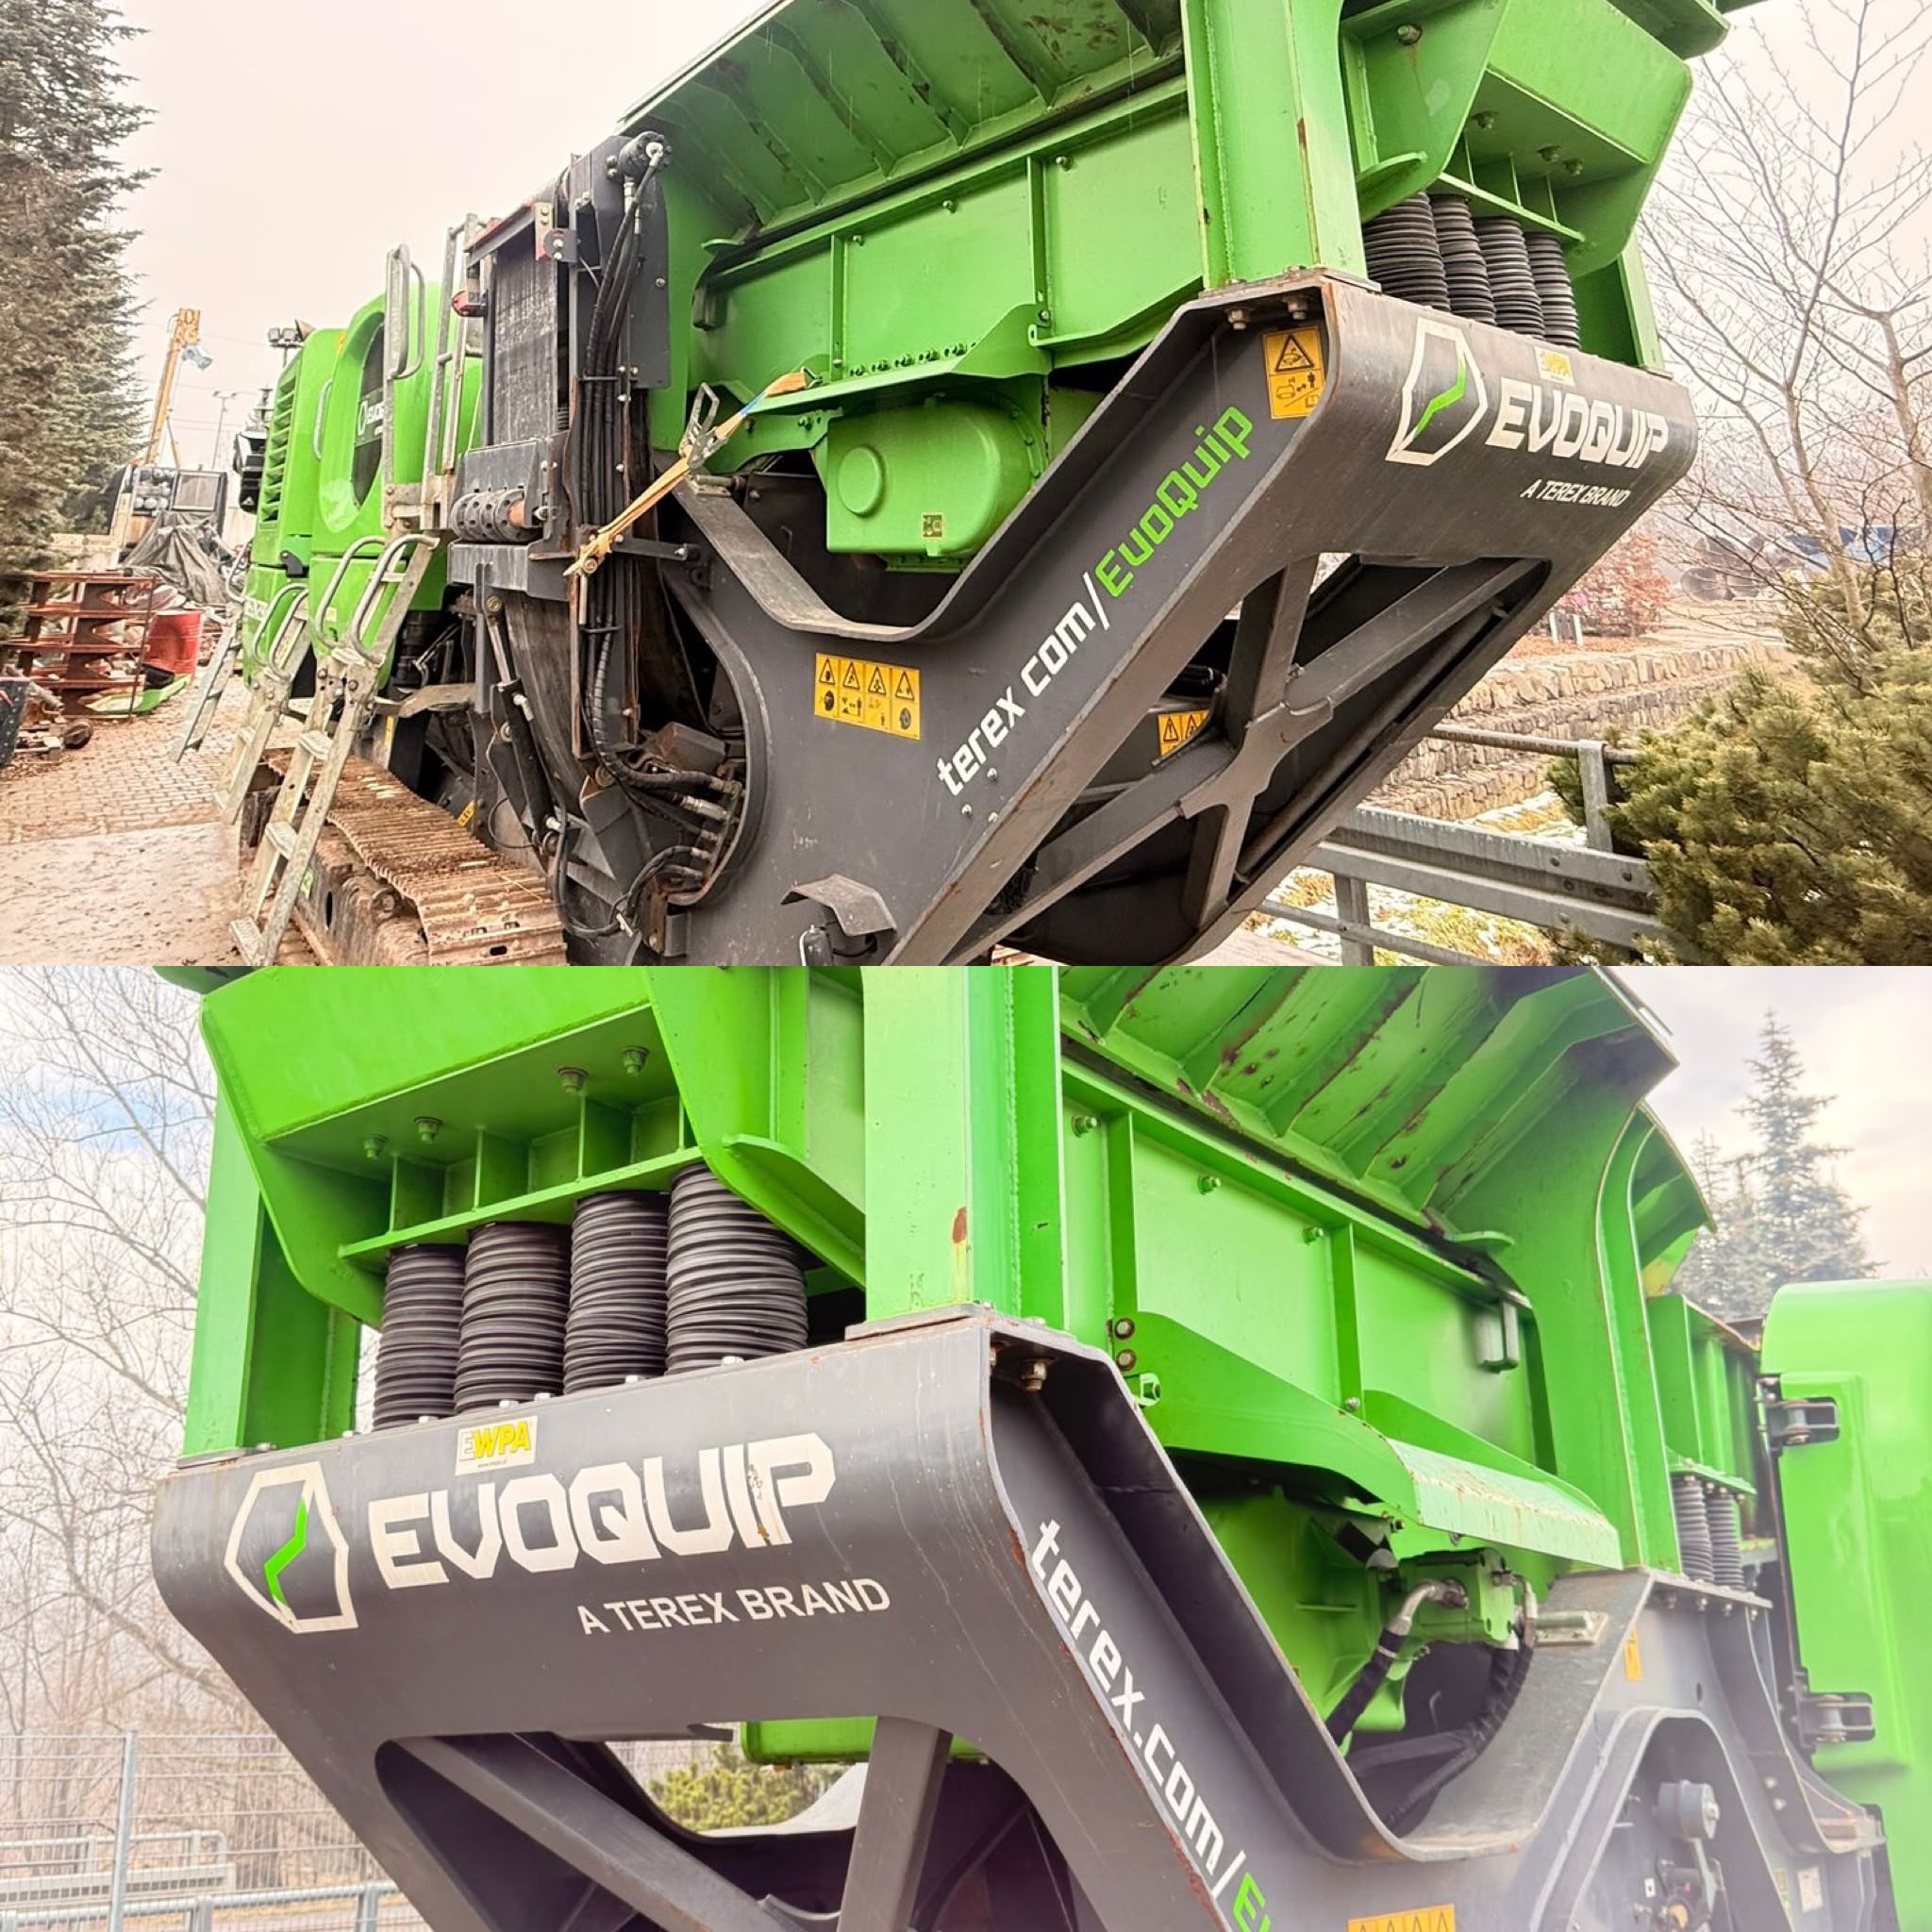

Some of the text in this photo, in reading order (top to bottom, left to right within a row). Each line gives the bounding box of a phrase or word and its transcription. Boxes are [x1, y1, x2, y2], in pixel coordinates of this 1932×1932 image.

[1485, 377, 1669, 469] EVOQUIP
[1520, 478, 1631, 508] A TEREX BRAND
[368, 1432, 836, 1590] EVOQUIP
[576, 1577, 891, 1635] A TEREX BRAND
